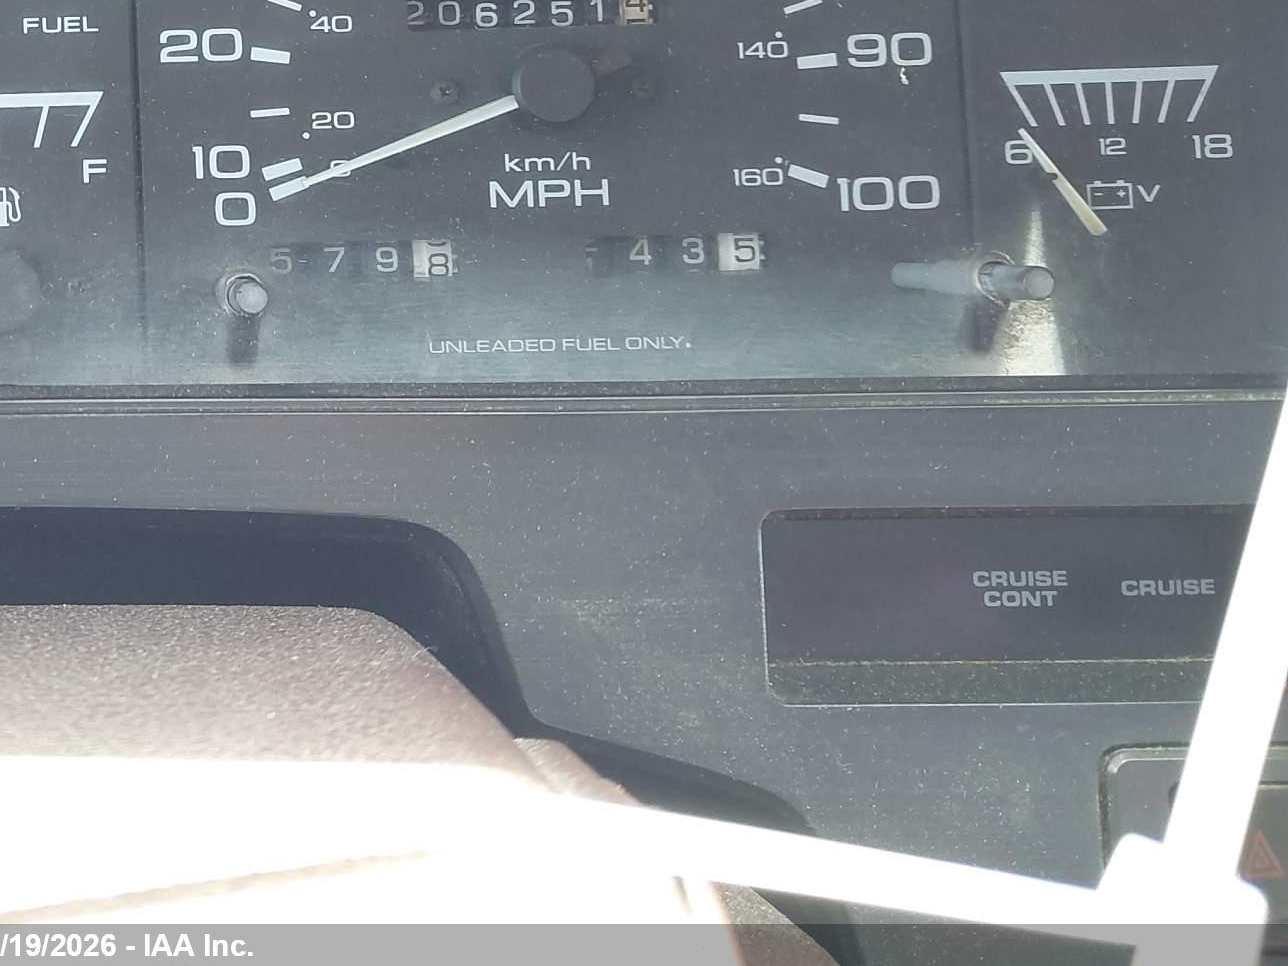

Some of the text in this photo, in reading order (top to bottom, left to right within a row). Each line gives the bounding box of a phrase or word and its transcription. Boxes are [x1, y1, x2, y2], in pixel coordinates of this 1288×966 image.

[22, 16, 99, 34] FUEL
[310, 15, 353, 33] 40
[159, 28, 243, 62] 20
[737, 41, 789, 59] 140
[847, 33, 933, 67] 90
[312, 111, 355, 129] 20
[1004, 133, 1234, 165] 6 12 18
[82, 159, 107, 183] F
[192, 145, 250, 179] 10
[504, 152, 592, 172] km/h
[733, 168, 784, 186] 160
[489, 179, 610, 209] MPH
[837, 175, 941, 212] 100
[1136, 185, 1160, 202] V
[215, 192, 256, 226] 0
[429, 339, 556, 354] UNLEADED
[562, 337, 620, 351] FUEL
[973, 570, 1068, 587] CRUISE
[1120, 578, 1216, 596] CRUISE
[983, 591, 1058, 607] CONT
